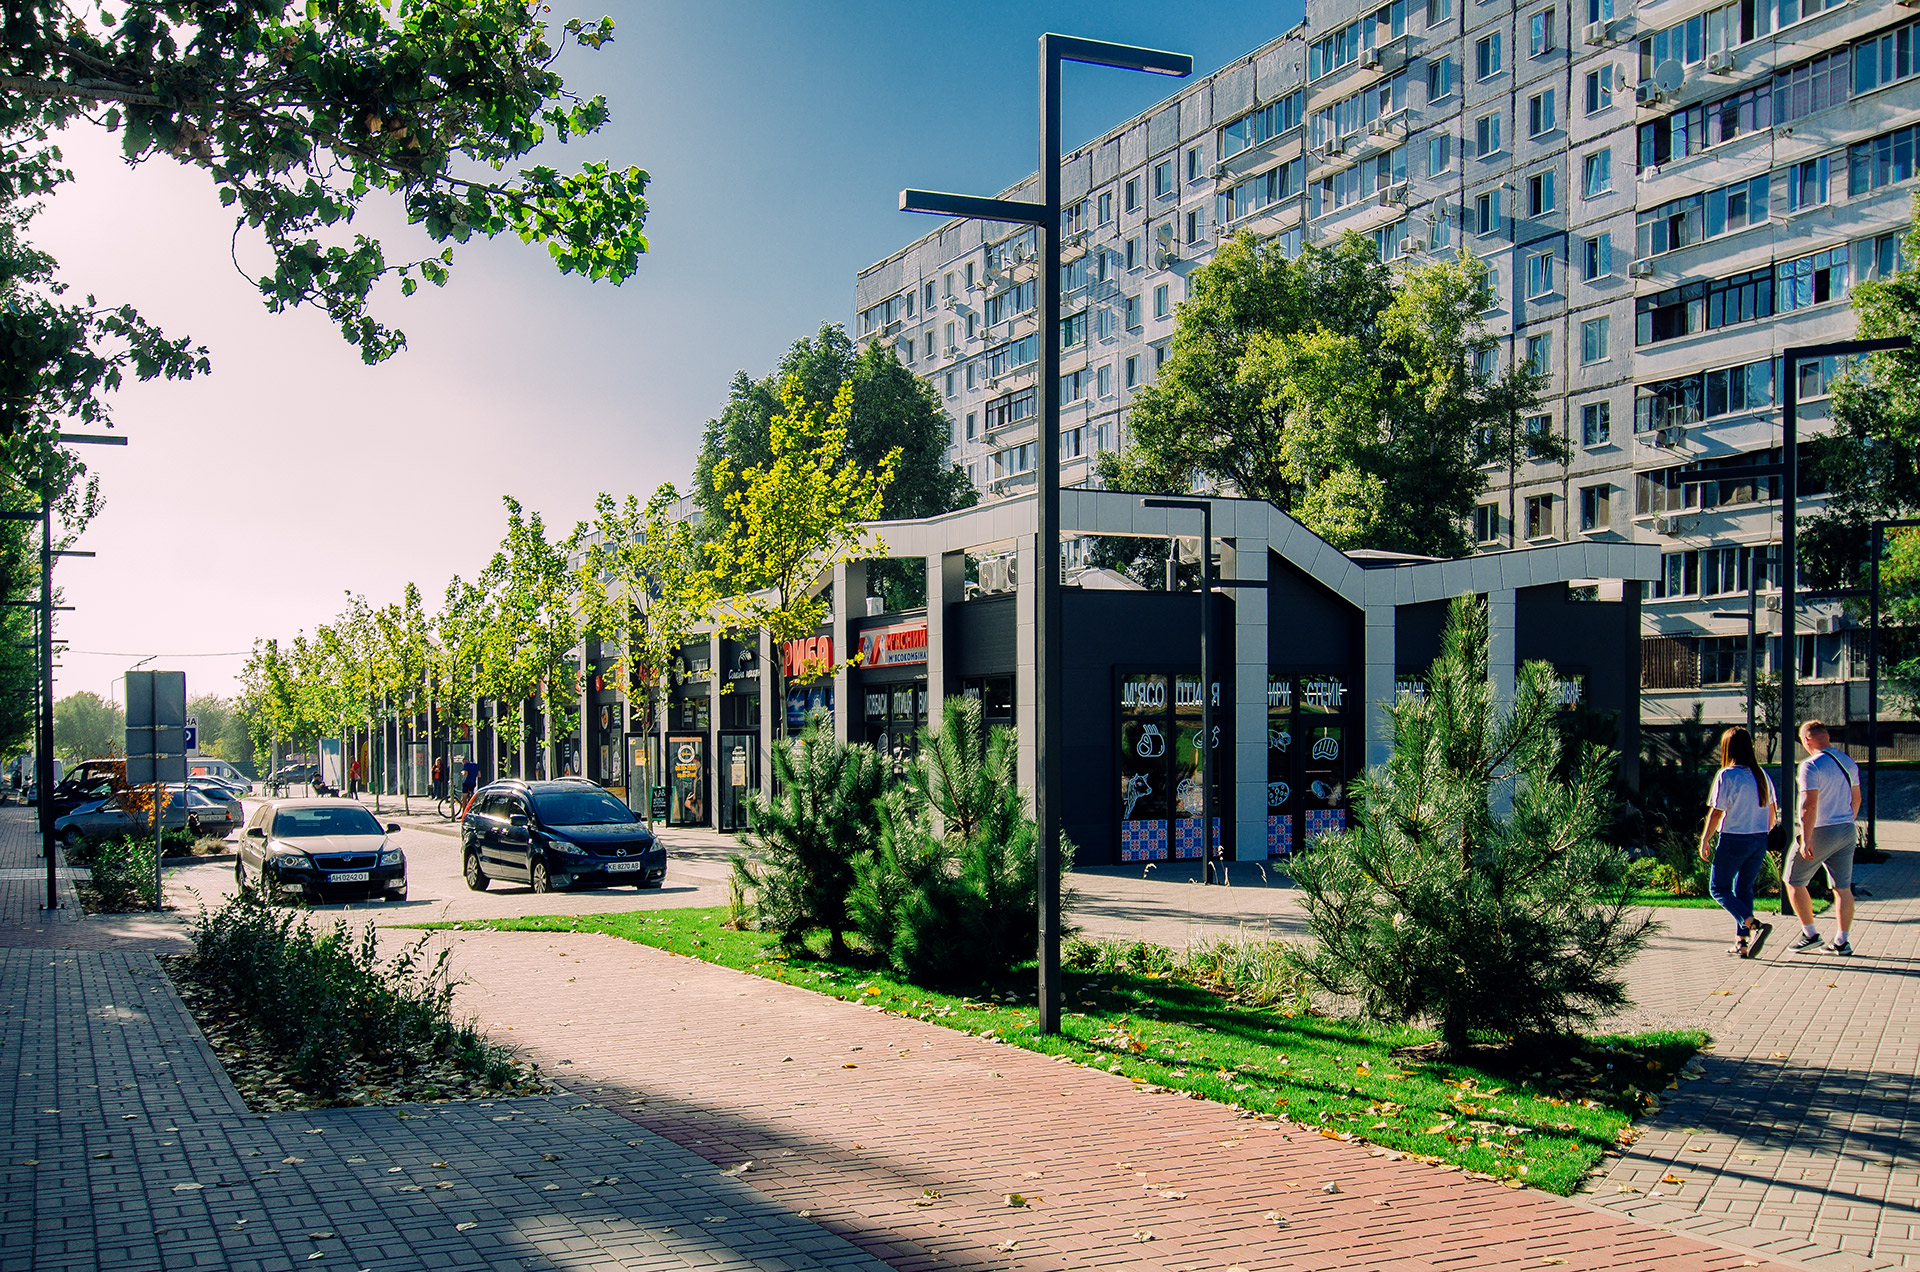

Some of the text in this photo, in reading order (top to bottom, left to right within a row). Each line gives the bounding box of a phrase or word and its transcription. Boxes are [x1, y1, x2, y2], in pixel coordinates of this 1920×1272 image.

[783, 635, 834, 677] РИБА
[1124, 682, 1165, 707] М'ЯСО
[1175, 682, 1220, 707] ПТИЯ
[1306, 676, 1343, 706] СТЕЙК
